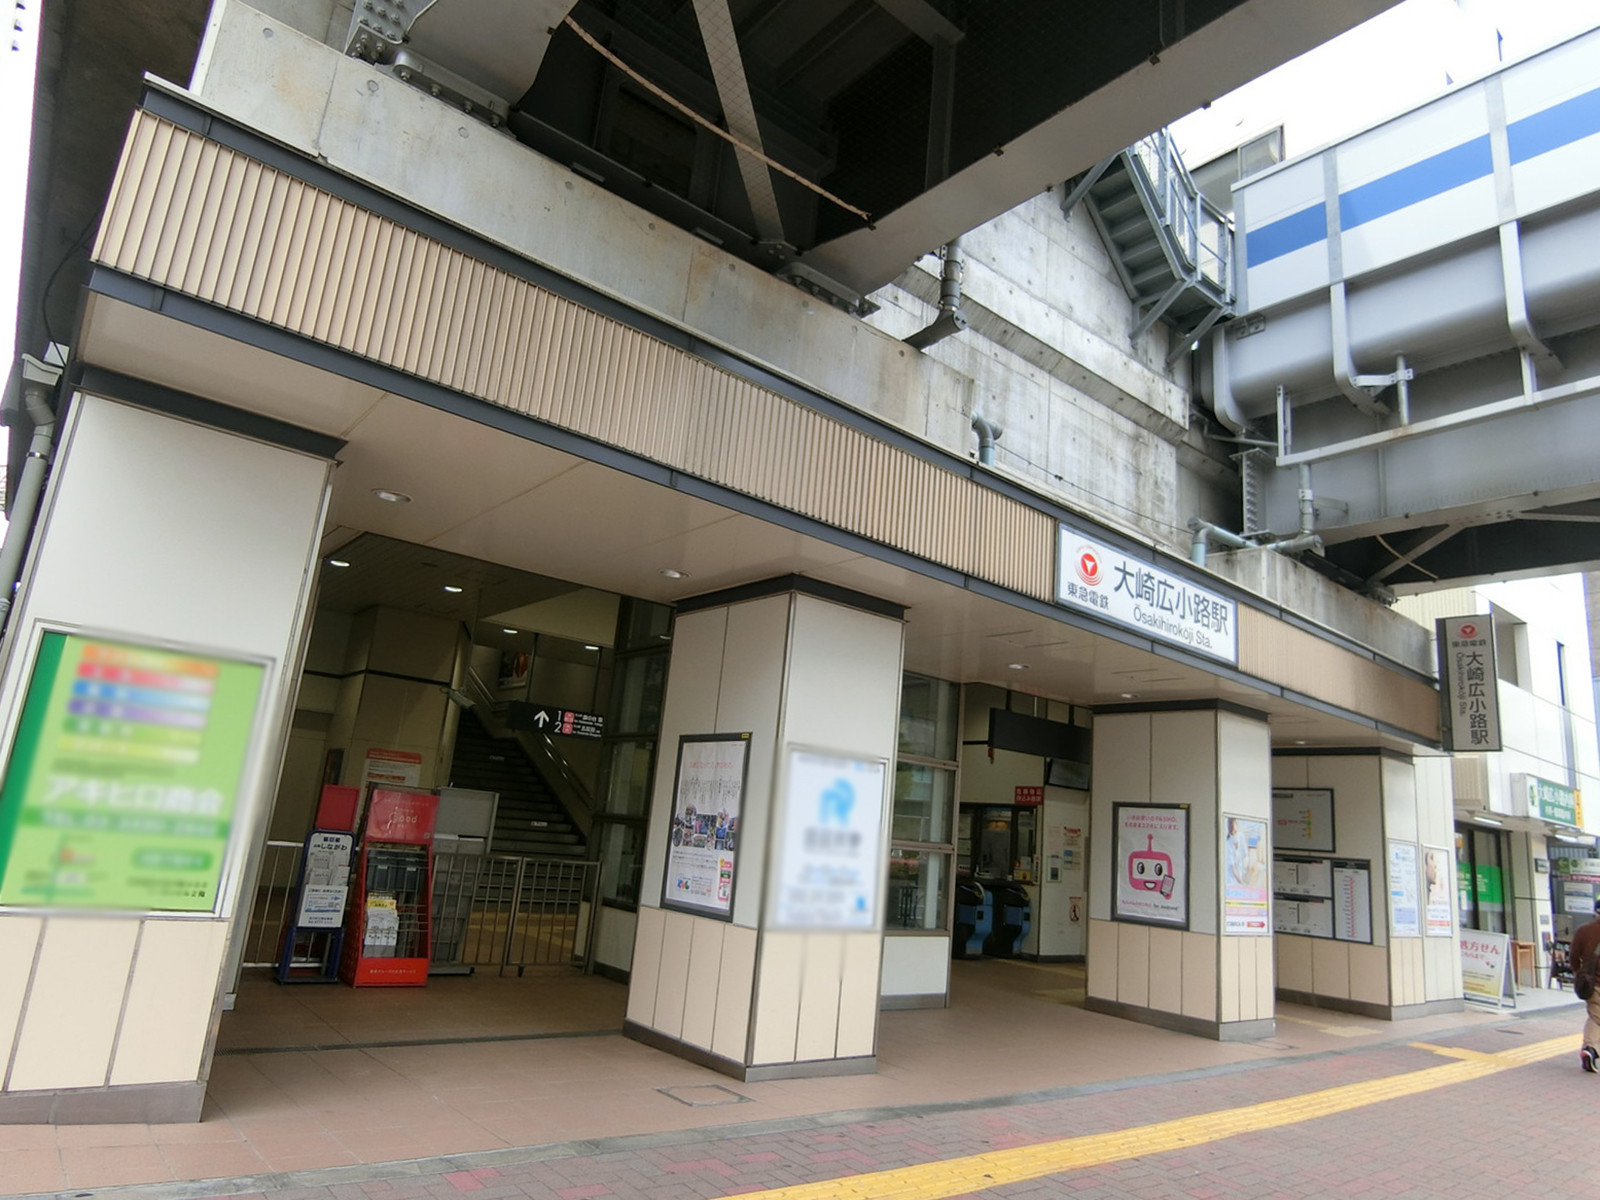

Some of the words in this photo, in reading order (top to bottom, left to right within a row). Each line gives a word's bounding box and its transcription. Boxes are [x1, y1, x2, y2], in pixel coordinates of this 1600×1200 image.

[1067, 581, 1110, 610] 東急電鉄
[1113, 560, 1229, 637] 大崎広小路駅
[1195, 630, 1213, 649] Sta.
[1466, 651, 1489, 745] 大崎広小路駅
[554, 721, 562, 733] 2
[557, 710, 562, 721] 1
